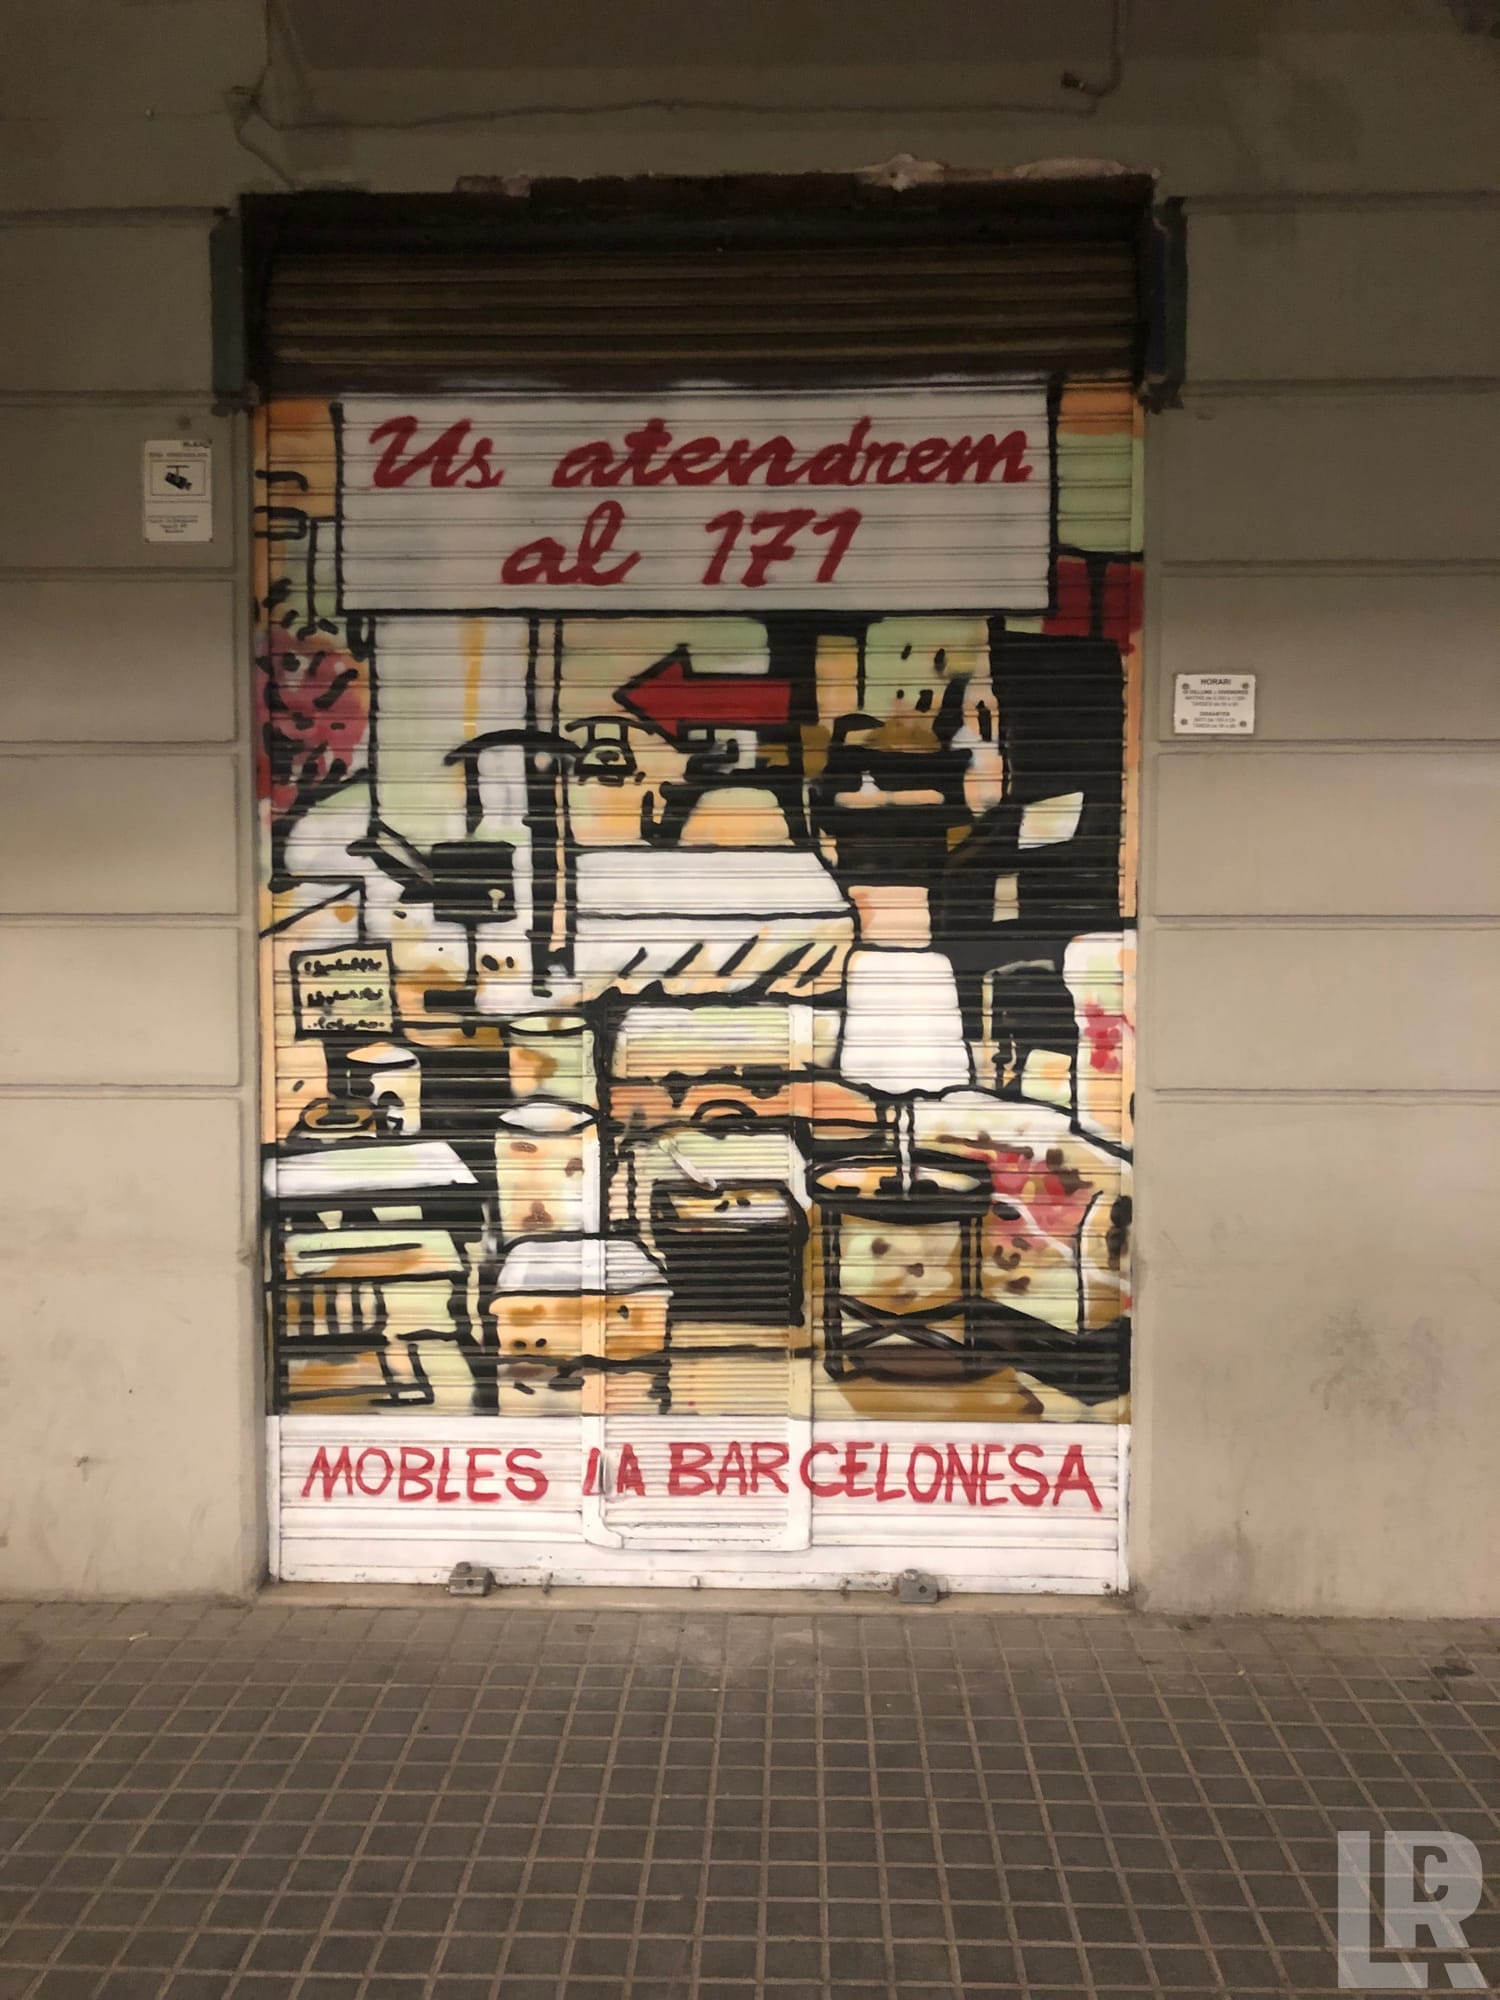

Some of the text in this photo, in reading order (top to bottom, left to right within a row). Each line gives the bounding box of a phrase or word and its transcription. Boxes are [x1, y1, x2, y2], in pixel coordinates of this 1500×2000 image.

[369, 416, 1032, 488] Us atendrem
[501, 501, 862, 587] al 171
[302, 1446, 548, 1502] MOBLES
[668, 1442, 1101, 1510] BARCELONESA
